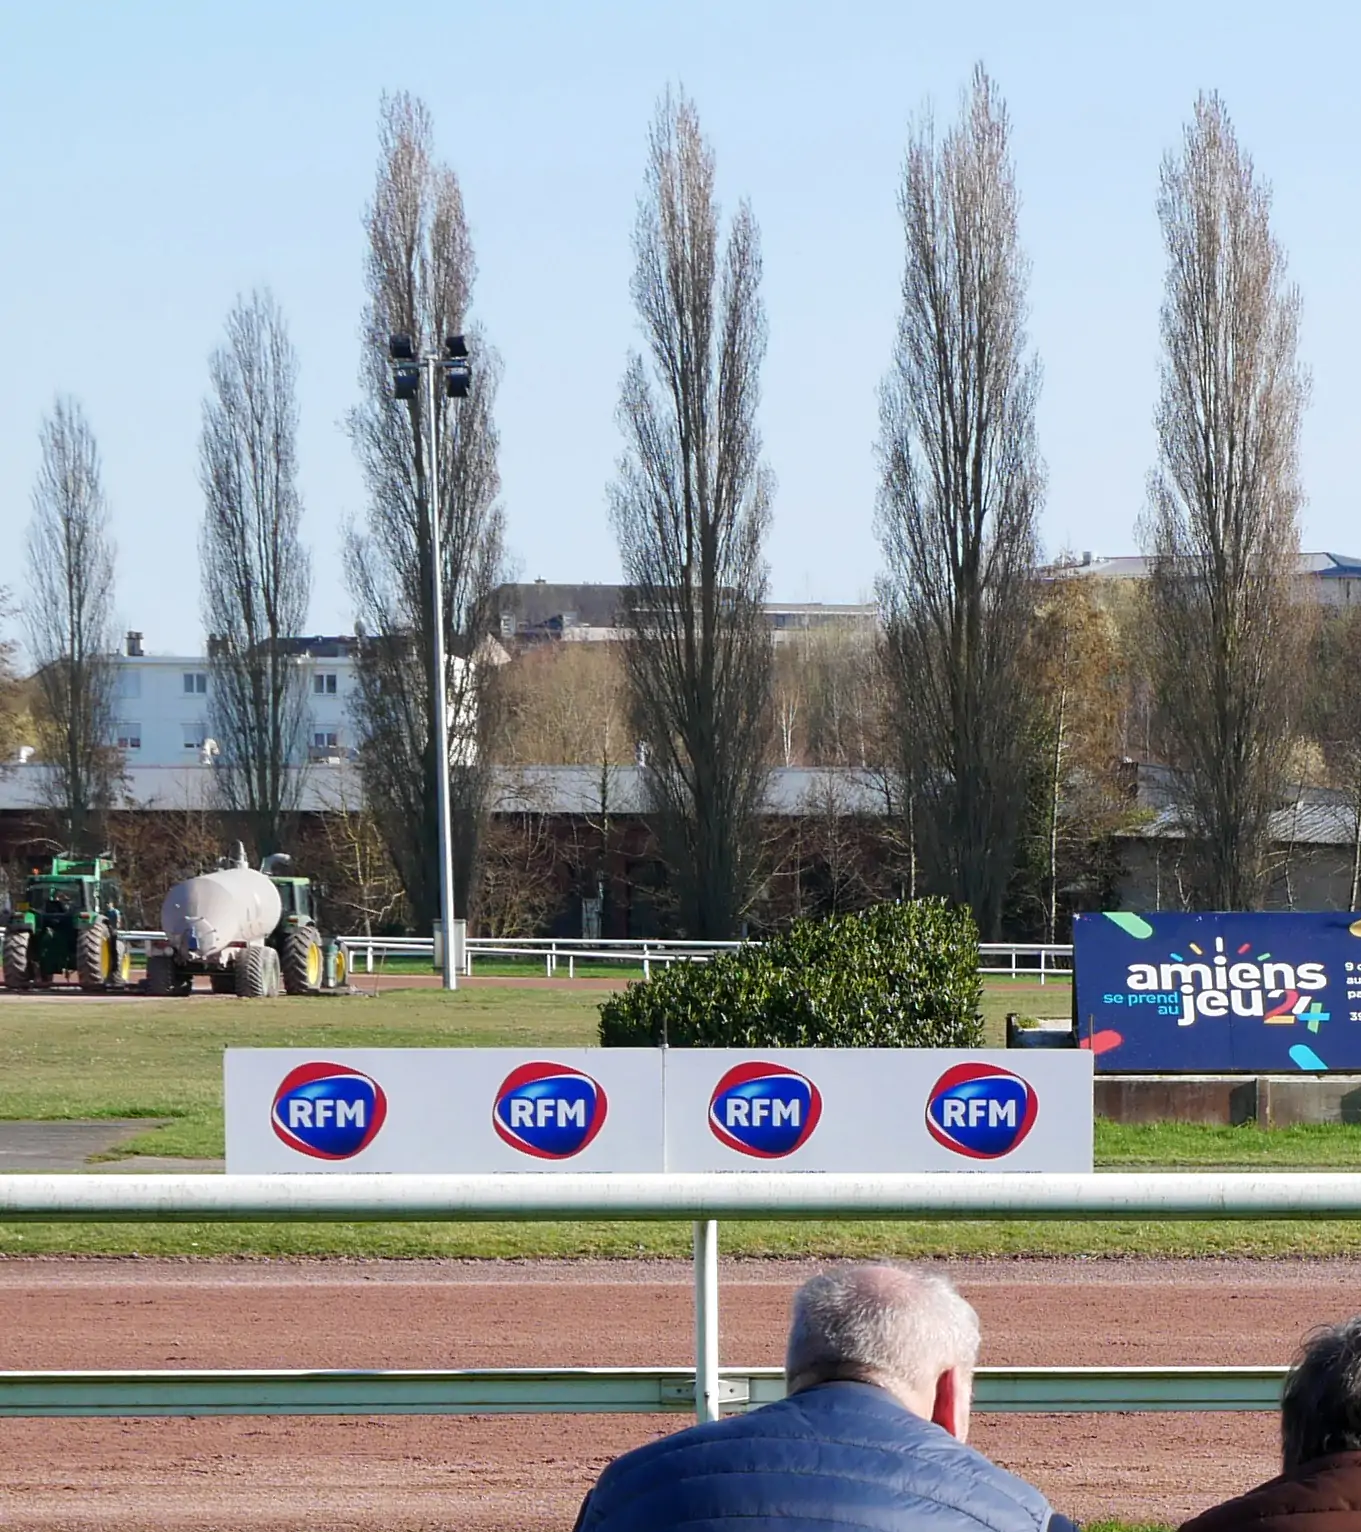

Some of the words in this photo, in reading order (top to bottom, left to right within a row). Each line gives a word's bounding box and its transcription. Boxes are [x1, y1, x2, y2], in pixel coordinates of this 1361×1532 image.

[1126, 955, 1327, 991] amiens
[1344, 962, 1354, 971] 9
[1103, 993, 1123, 1004] se
[1128, 992, 1179, 1007] prend
[1158, 1005, 1180, 1015] au
[289, 1098, 366, 1128] RFM
[510, 1098, 586, 1128] RFM
[725, 1097, 801, 1127] RFM
[942, 1098, 1017, 1128] RFM
